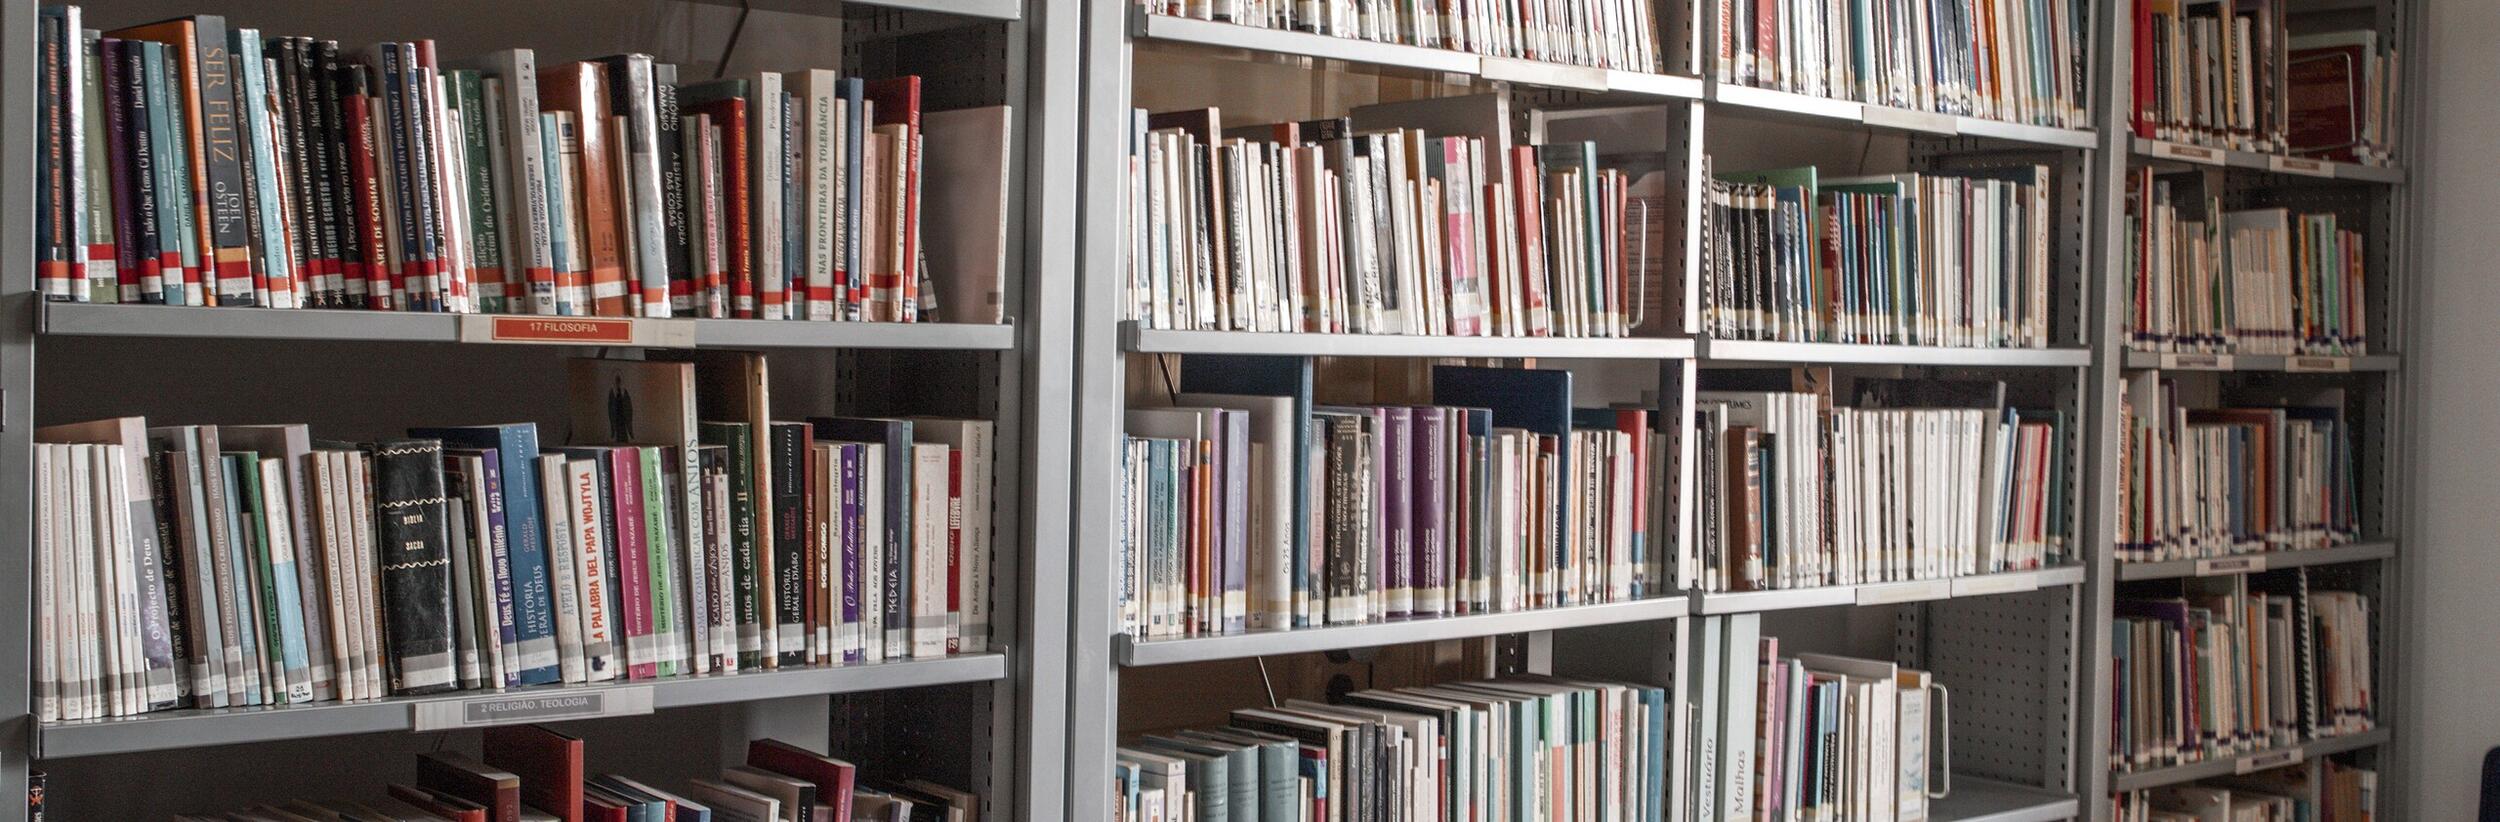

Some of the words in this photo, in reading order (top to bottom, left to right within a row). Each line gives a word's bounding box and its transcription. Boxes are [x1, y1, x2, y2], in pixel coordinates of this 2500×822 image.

[204, 47, 226, 90] SER
[659, 85, 669, 131] DAMÁSIO
[668, 84, 679, 131] ANTÓNIO
[207, 100, 234, 162] FELIZ
[816, 96, 828, 163] TOLERÂNCIA
[672, 152, 678, 160] A
[665, 172, 675, 190] DAS
[673, 161, 685, 209] ESTRANHA
[818, 167, 827, 180] DA
[369, 177, 381, 221] SONHAR
[480, 167, 492, 212] Ocidente
[214, 181, 230, 233] OSTEEN
[228, 193, 242, 223] JOEL
[485, 215, 494, 228] do
[667, 192, 677, 227] COISAS
[818, 183, 828, 250] FRONTEIRAS
[373, 225, 383, 238] DE
[677, 212, 686, 246] ORDEM
[374, 242, 386, 266] ARTE
[478, 234, 488, 267] adição
[818, 254, 827, 274] NAS
[530, 322, 542, 330] 17
[545, 323, 598, 333] FILOSOFIA
[686, 438, 699, 496] ANJOS
[580, 472, 594, 522] WOJTYLA
[651, 512, 659, 541] NAZARÉ
[691, 501, 700, 528] COM
[493, 524, 506, 557] Milénio
[555, 520, 571, 570] RESPOSTA
[585, 526, 596, 554] PAPA
[627, 516, 636, 547] NAZARÉ
[142, 538, 153, 565] Deus
[630, 548, 637, 558] DE
[654, 543, 660, 553] DE
[720, 543, 729, 577] ANJOS
[739, 541, 750, 569] cada
[145, 568, 154, 581] de
[221, 563, 228, 573] DO
[496, 558, 508, 579] Novo
[534, 565, 545, 592] DEUS
[587, 559, 599, 576] DEL
[631, 560, 639, 584] JESUS
[693, 532, 705, 603] COMUNICAR
[791, 552, 799, 580] DIABO
[333, 570, 341, 598] PODER
[634, 585, 640, 596] DE
[657, 580, 663, 590] DE
[740, 574, 751, 589] de
[782, 568, 791, 610] HISTÓRIA
[145, 584, 160, 627] Projecto
[497, 592, 511, 602] Fé
[522, 581, 536, 633] HISTÓRIA
[561, 584, 575, 615] APELO
[586, 578, 604, 628] PALABRA
[722, 592, 732, 622] CURA
[791, 594, 800, 622] GERAL
[152, 630, 161, 640] O
[697, 605, 707, 641] COMO
[481, 704, 488, 712] 2
[541, 696, 588, 708] TEOLOGIA
[1701, 737, 1714, 818] Vestuário
[1733, 749, 1746, 814] Malhas
